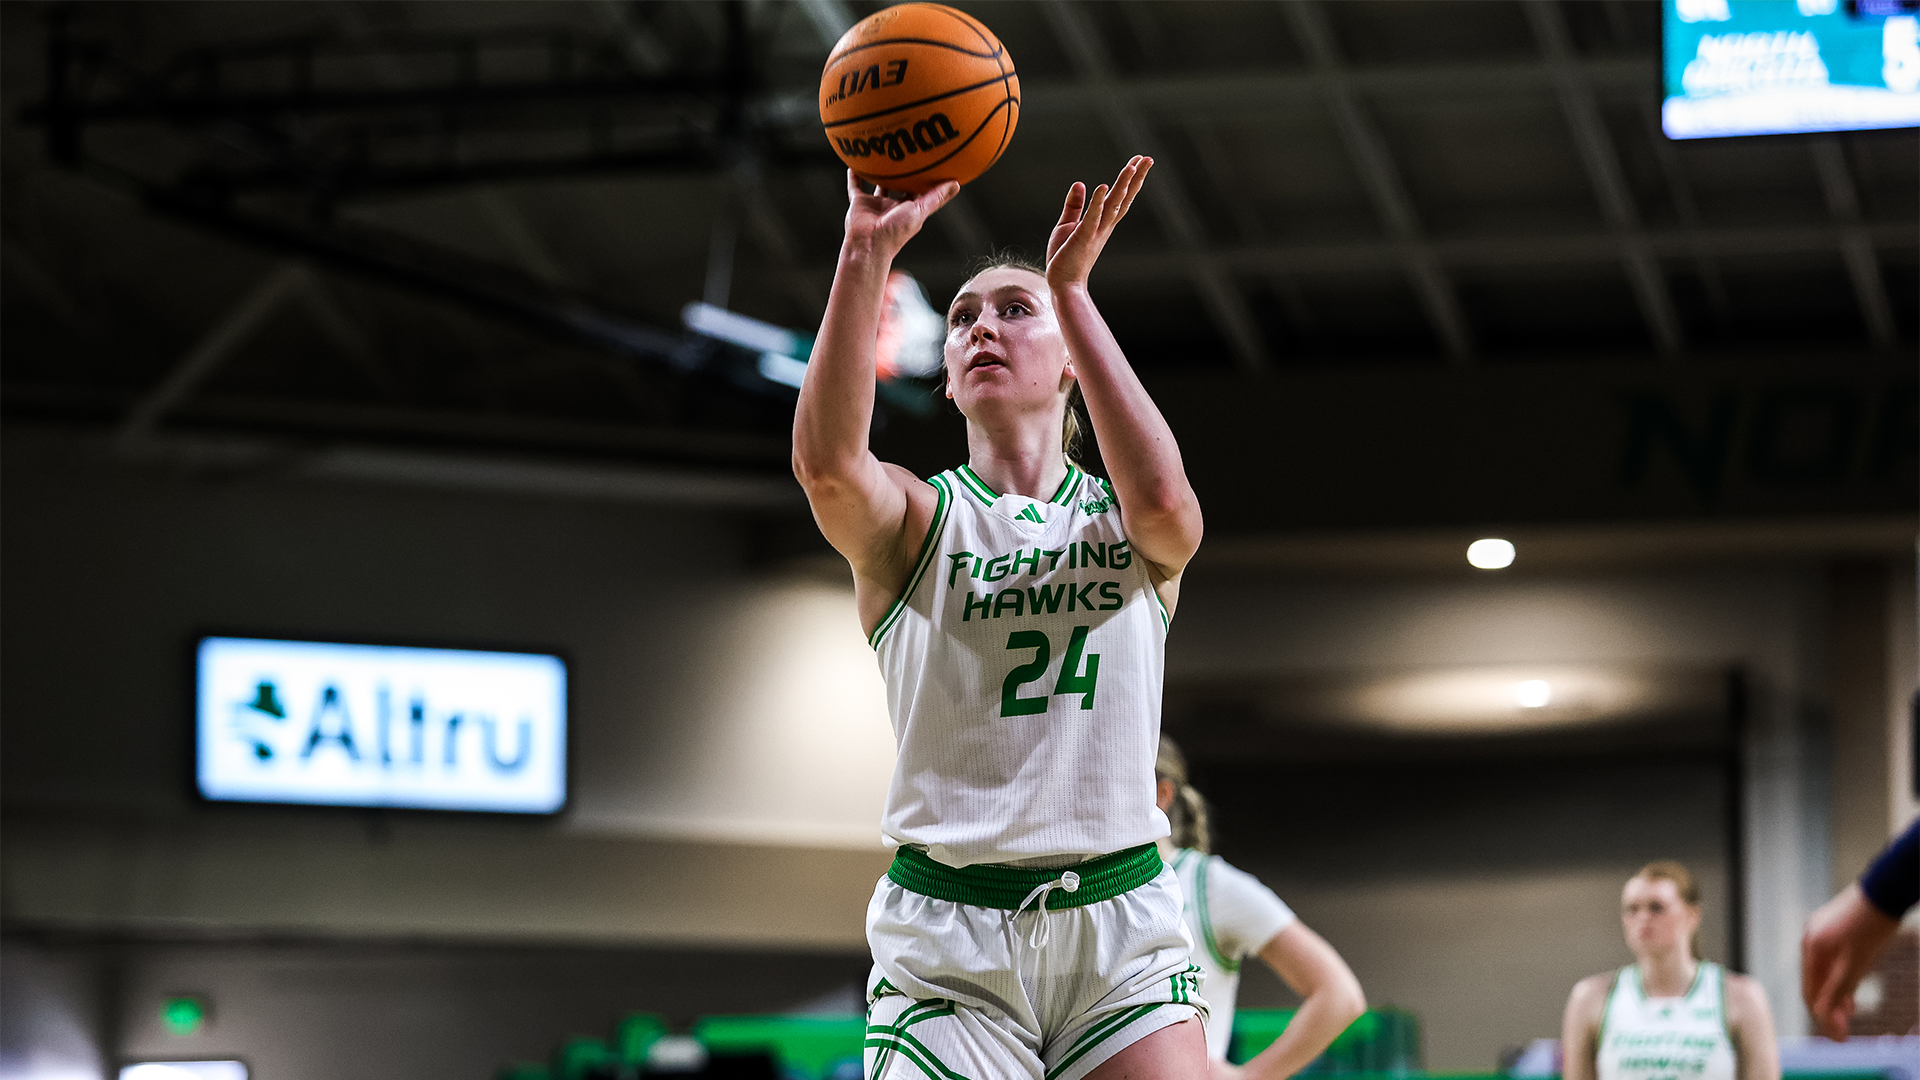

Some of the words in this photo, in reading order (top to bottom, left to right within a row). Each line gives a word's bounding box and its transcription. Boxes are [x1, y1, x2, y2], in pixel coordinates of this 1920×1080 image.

[838, 59, 908, 101] EVO
[835, 113, 959, 161] Wilson
[946, 540, 1132, 590] FIGHTING
[963, 582, 1124, 622] HAWKS
[1000, 625, 1101, 718] 24
[300, 683, 536, 774] Altru
